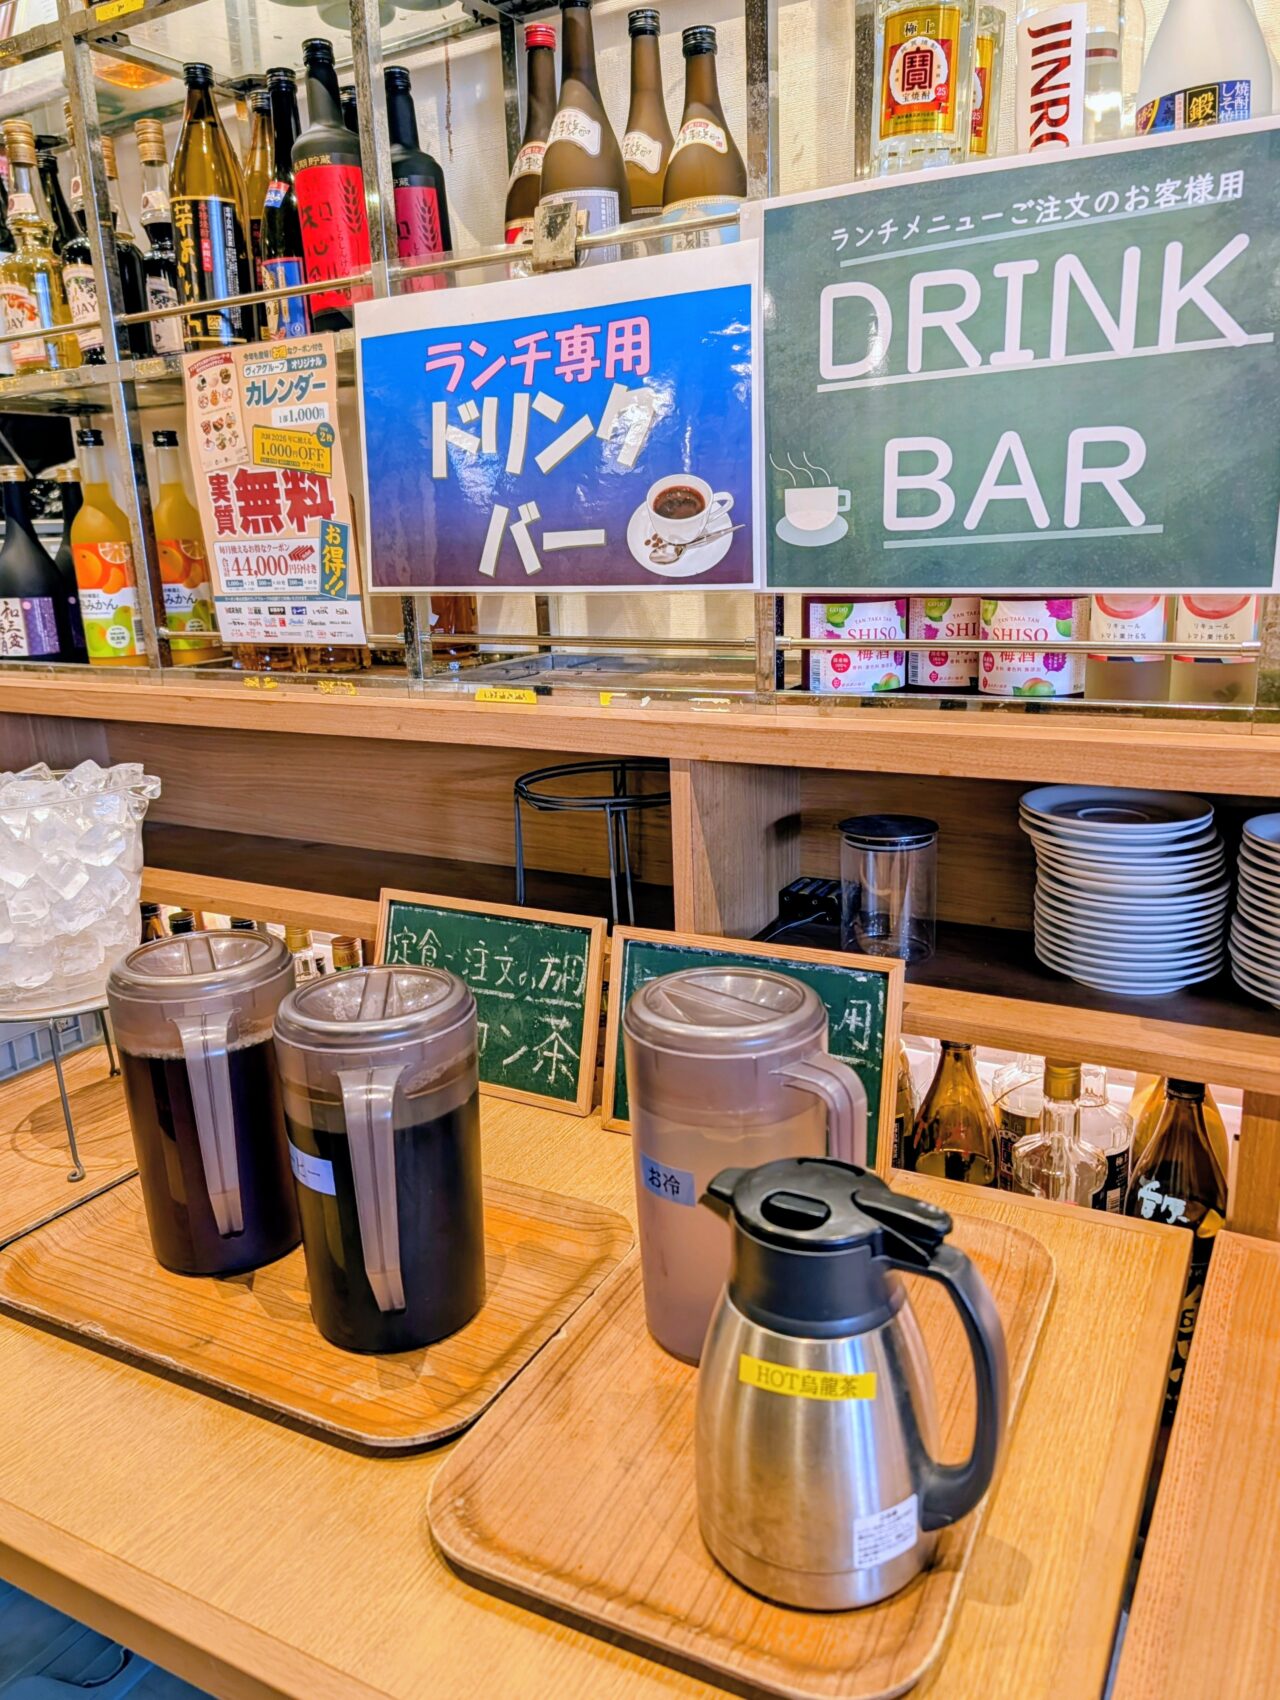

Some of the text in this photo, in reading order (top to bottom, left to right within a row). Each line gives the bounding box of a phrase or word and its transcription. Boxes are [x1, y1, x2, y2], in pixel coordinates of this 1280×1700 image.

[936, 86, 947, 96] 25
[831, 169, 1245, 251] ランチメニューご注文のお客様用
[820, 233, 1250, 379] DRINK
[245, 361, 286, 377] ヴィアグループ
[291, 356, 323, 371] オリジナル
[424, 316, 651, 393] ランチ専用
[245, 372, 327, 407] カレンダー
[431, 382, 657, 479] ドリンク
[883, 425, 1147, 531] BAR
[208, 473, 238, 535] 実質
[233, 468, 335, 534] 無料
[478, 500, 607, 578] バー
[847, 626, 897, 640] SHISO
[945, 622, 979, 637] SHI
[993, 627, 1049, 640] SHISO
[1106, 622, 1141, 630] リキュール
[1193, 622, 1230, 630] リキュール
[647, 1166, 681, 1197] お冷
[755, 1363, 858, 1398] HOT烏龍茶
